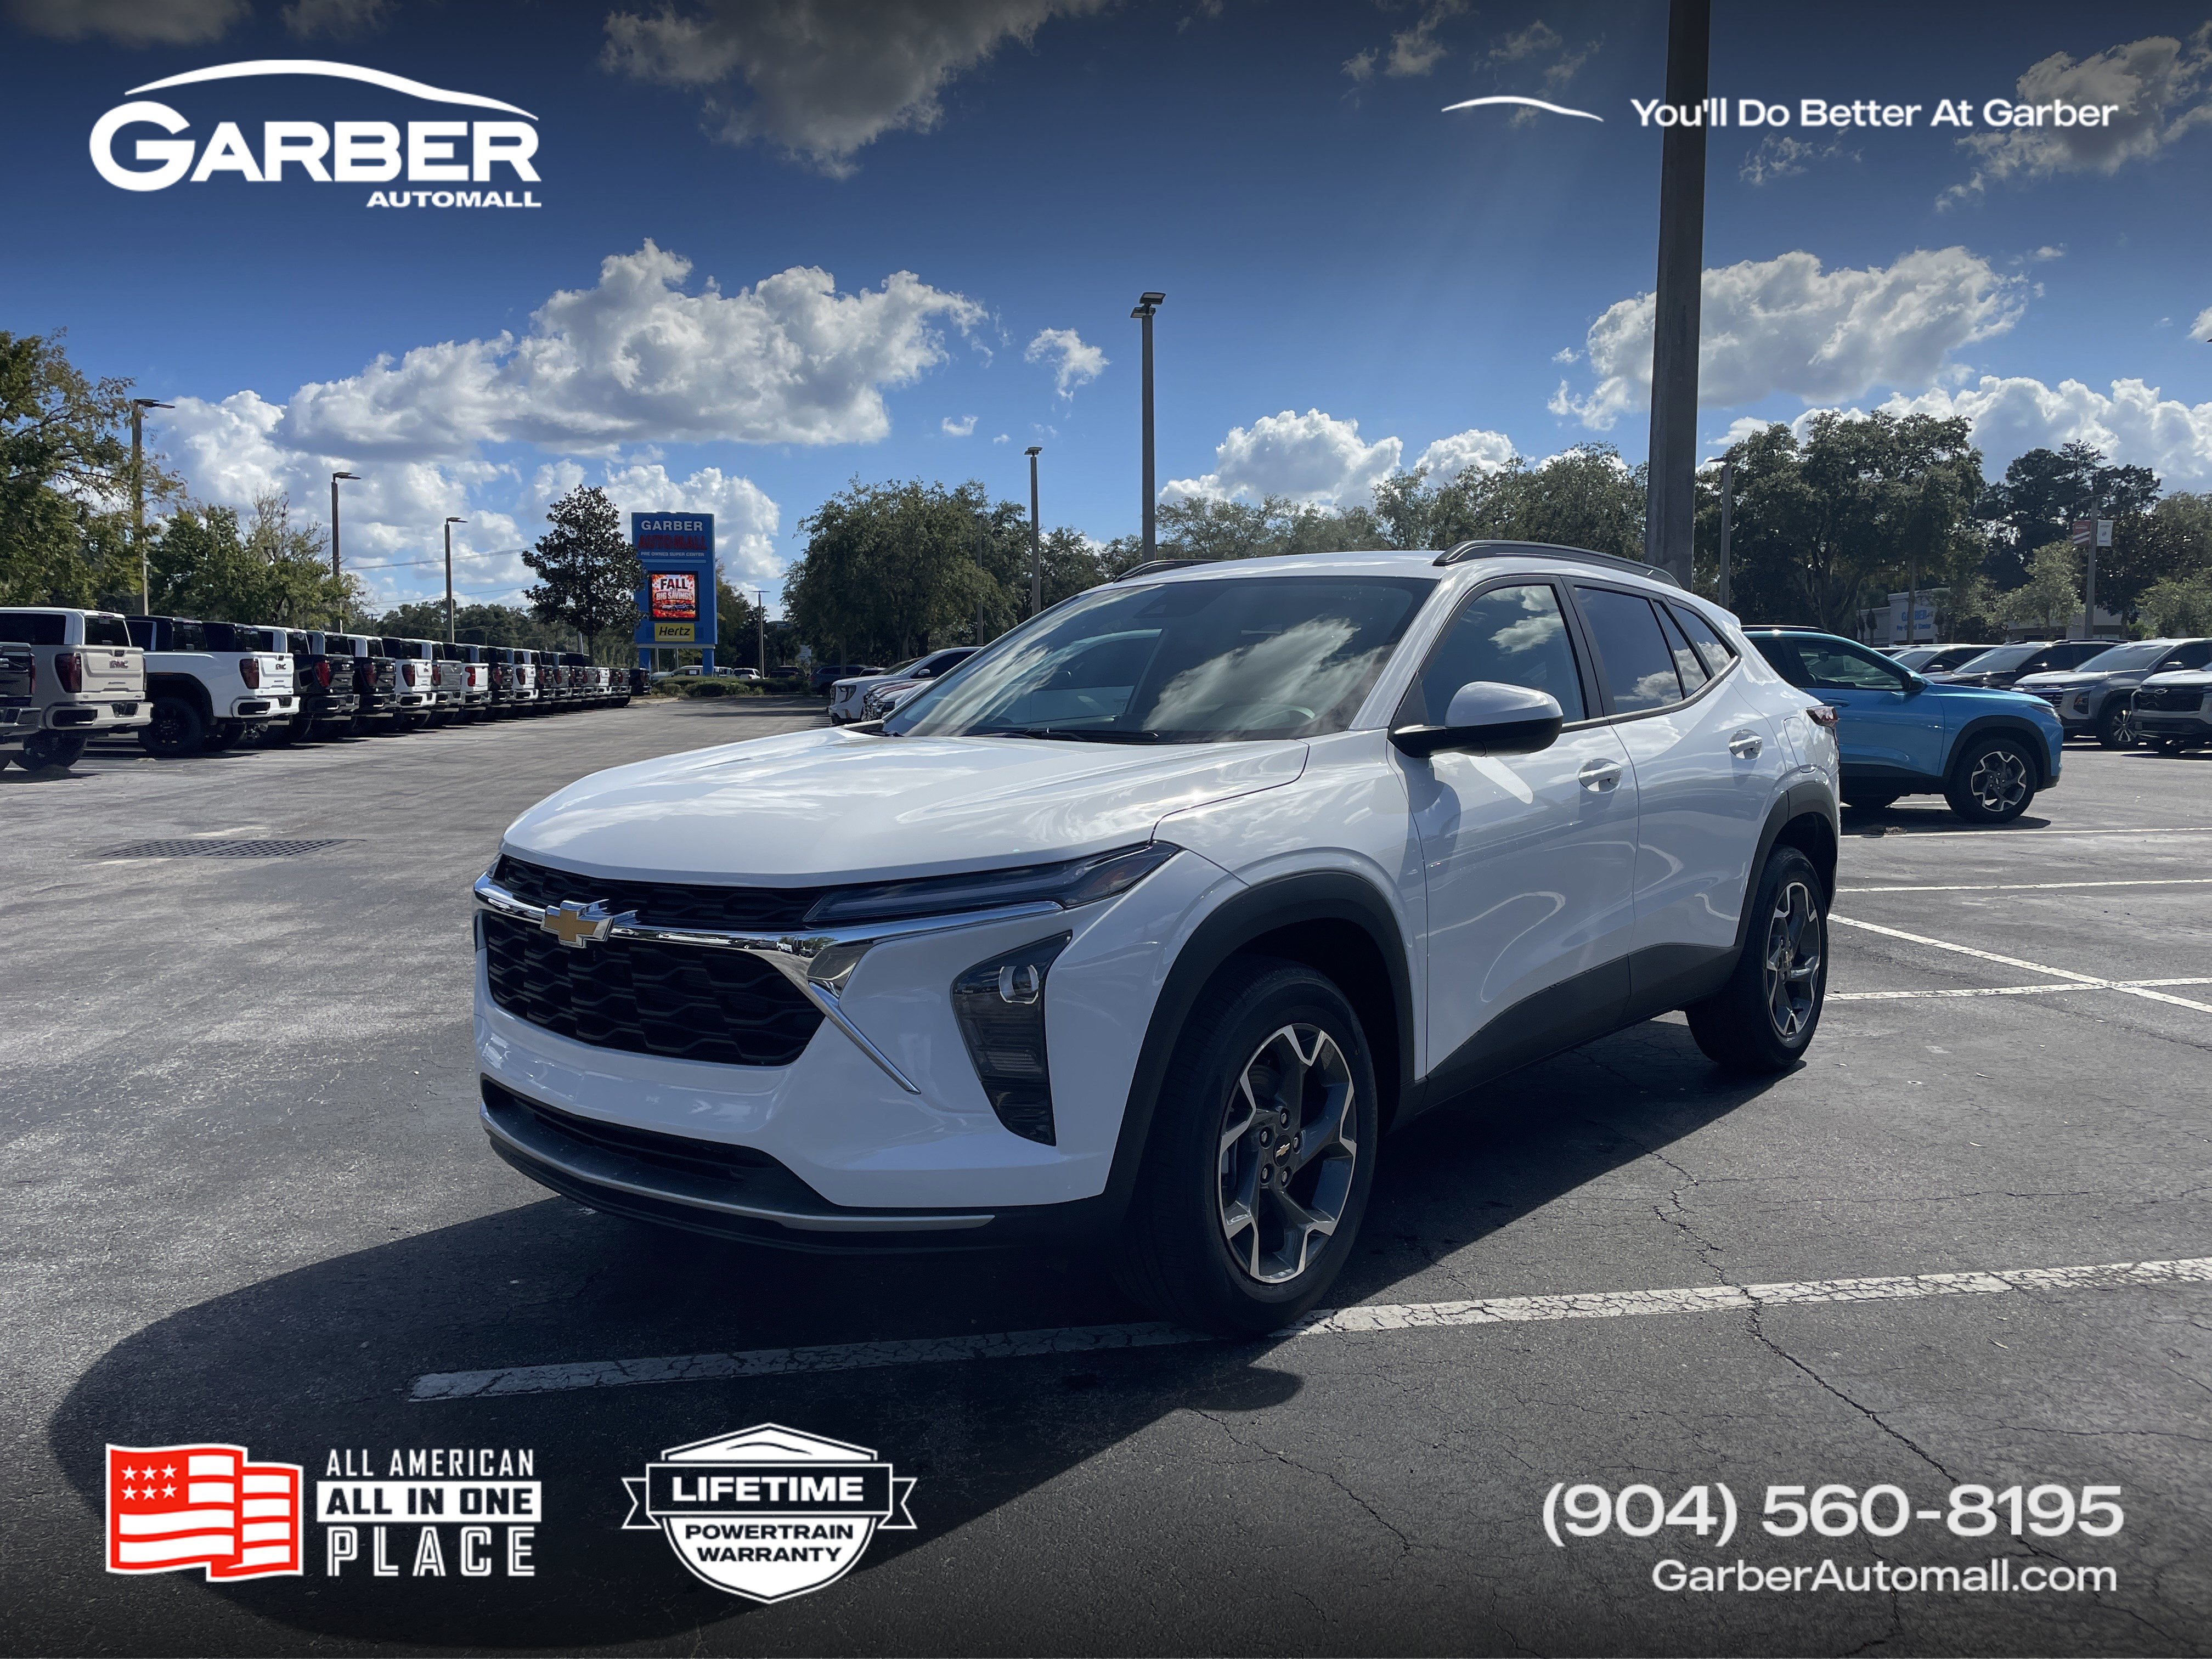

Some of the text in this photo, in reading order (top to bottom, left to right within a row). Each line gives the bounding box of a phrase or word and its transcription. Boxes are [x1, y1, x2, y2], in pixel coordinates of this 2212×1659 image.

[641, 520, 703, 531] GARBER
[638, 534, 707, 550] AUTOMALL
[661, 578, 688, 590] FALL
[656, 591, 693, 601] BIG SAVINGS
[659, 626, 690, 636] Hertz
